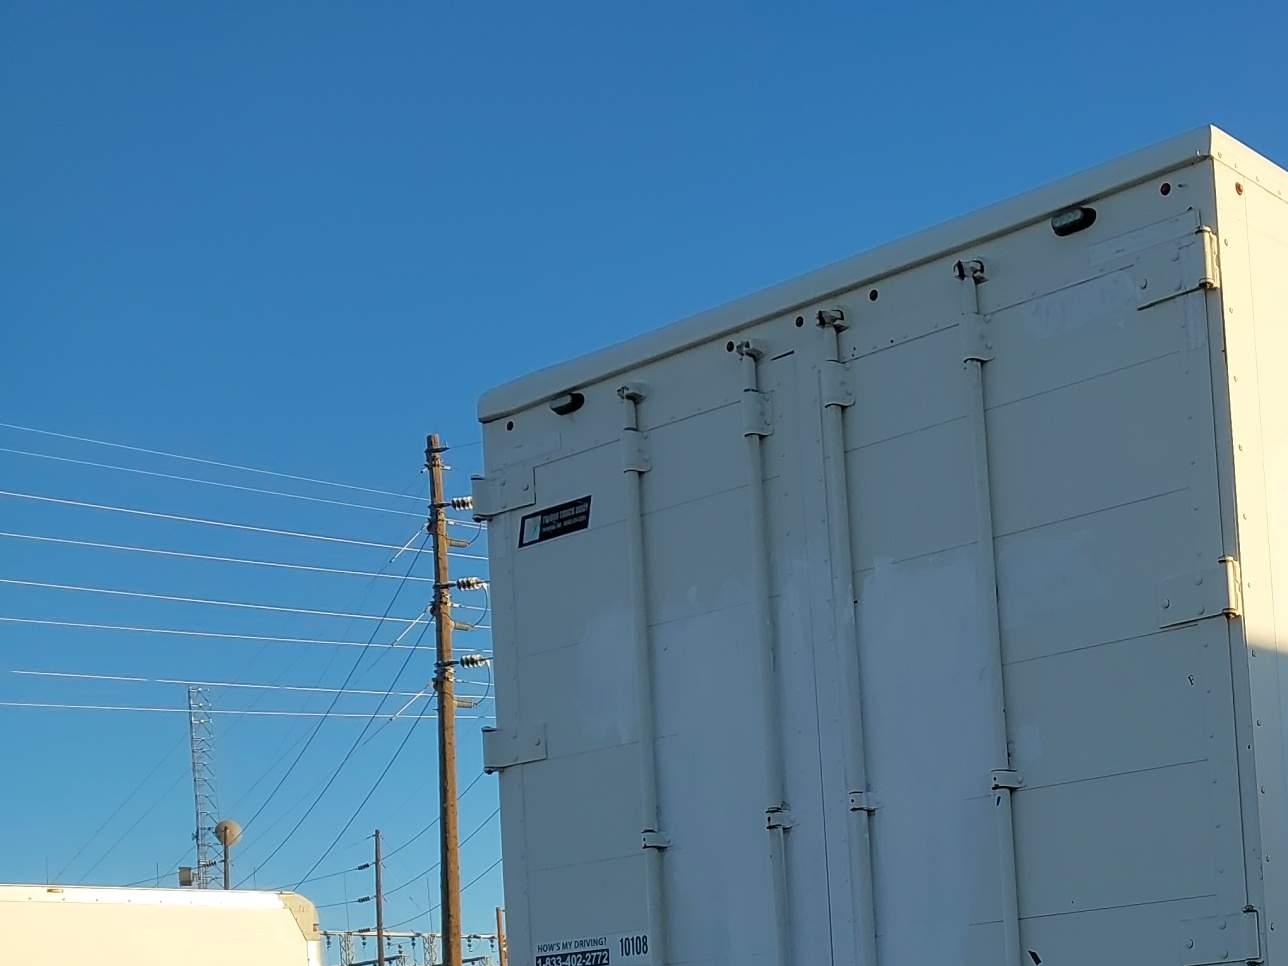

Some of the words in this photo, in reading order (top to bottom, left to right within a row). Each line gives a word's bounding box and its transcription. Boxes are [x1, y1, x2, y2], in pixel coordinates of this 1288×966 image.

[537, 942, 560, 953] HOW'S
[562, 941, 573, 950] MY
[574, 937, 607, 949] DRIVING?
[619, 935, 648, 956] 10108
